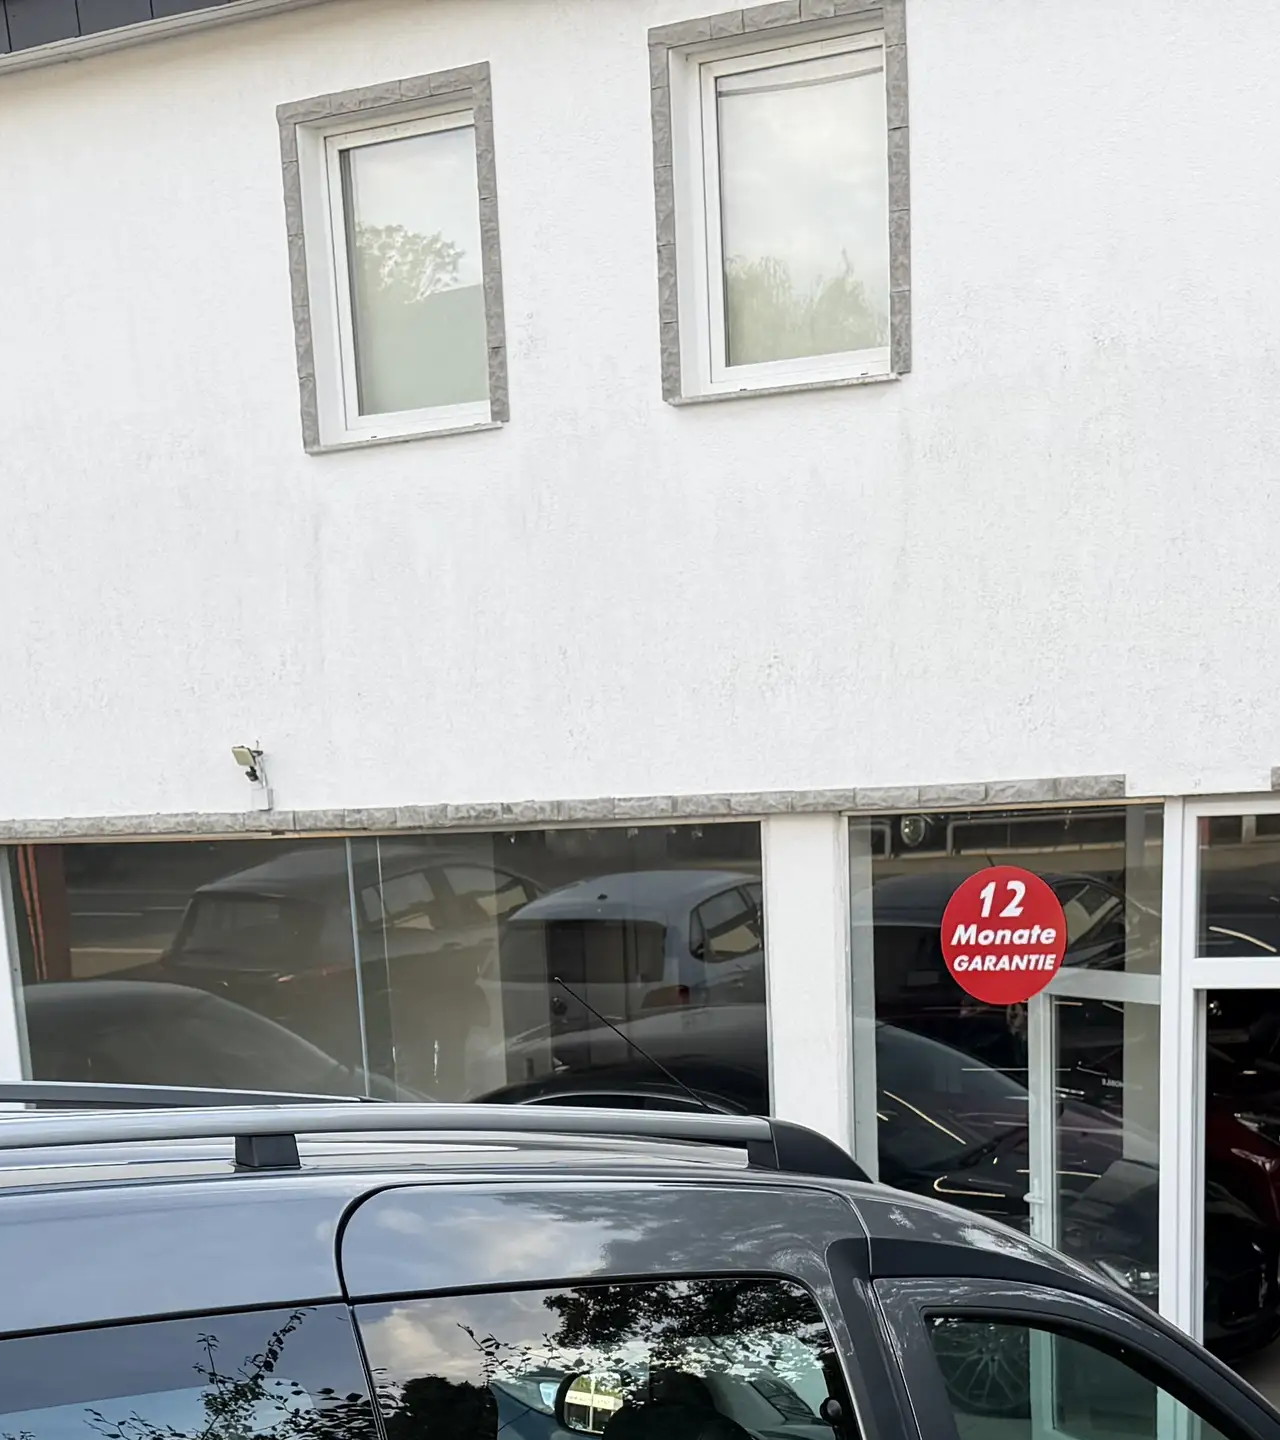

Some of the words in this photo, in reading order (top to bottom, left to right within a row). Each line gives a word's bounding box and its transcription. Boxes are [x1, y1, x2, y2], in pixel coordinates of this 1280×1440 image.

[980, 880, 1026, 917] 12
[951, 924, 1057, 945] Monate
[953, 954, 1057, 971] GARANTIE
